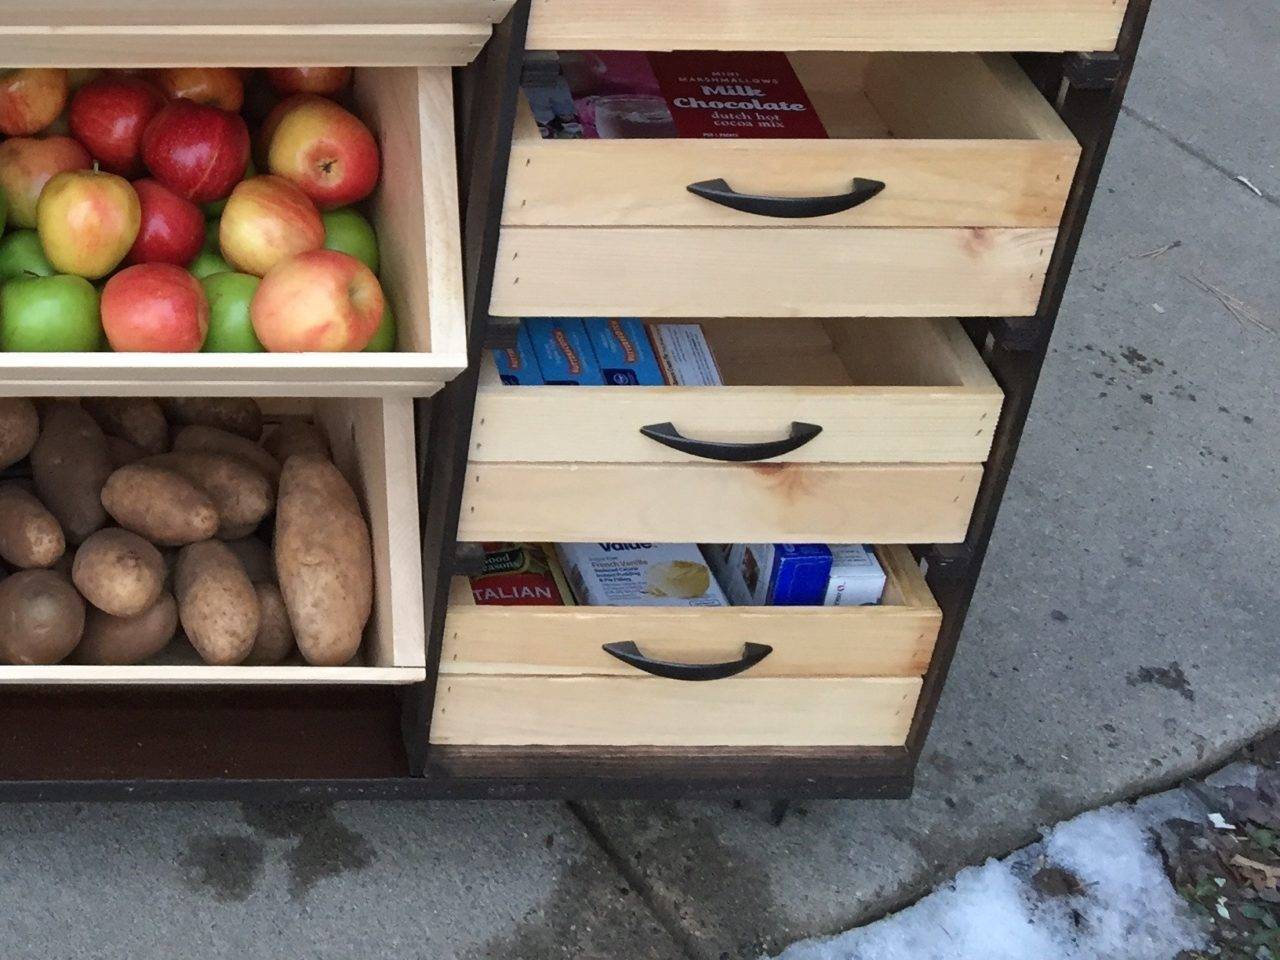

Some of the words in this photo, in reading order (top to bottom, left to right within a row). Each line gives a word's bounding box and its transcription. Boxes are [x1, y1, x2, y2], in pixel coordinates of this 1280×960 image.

[678, 76, 779, 85] MARSHMALLOWS
[700, 85, 767, 97] Milk
[673, 97, 807, 112] Chocolate
[711, 111, 751, 120] dutch
[755, 112, 781, 121] hot
[758, 120, 785, 128] mix
[483, 553, 510, 565] ood
[619, 559, 648, 567] Vanilla
[473, 585, 552, 601] TALIAN
